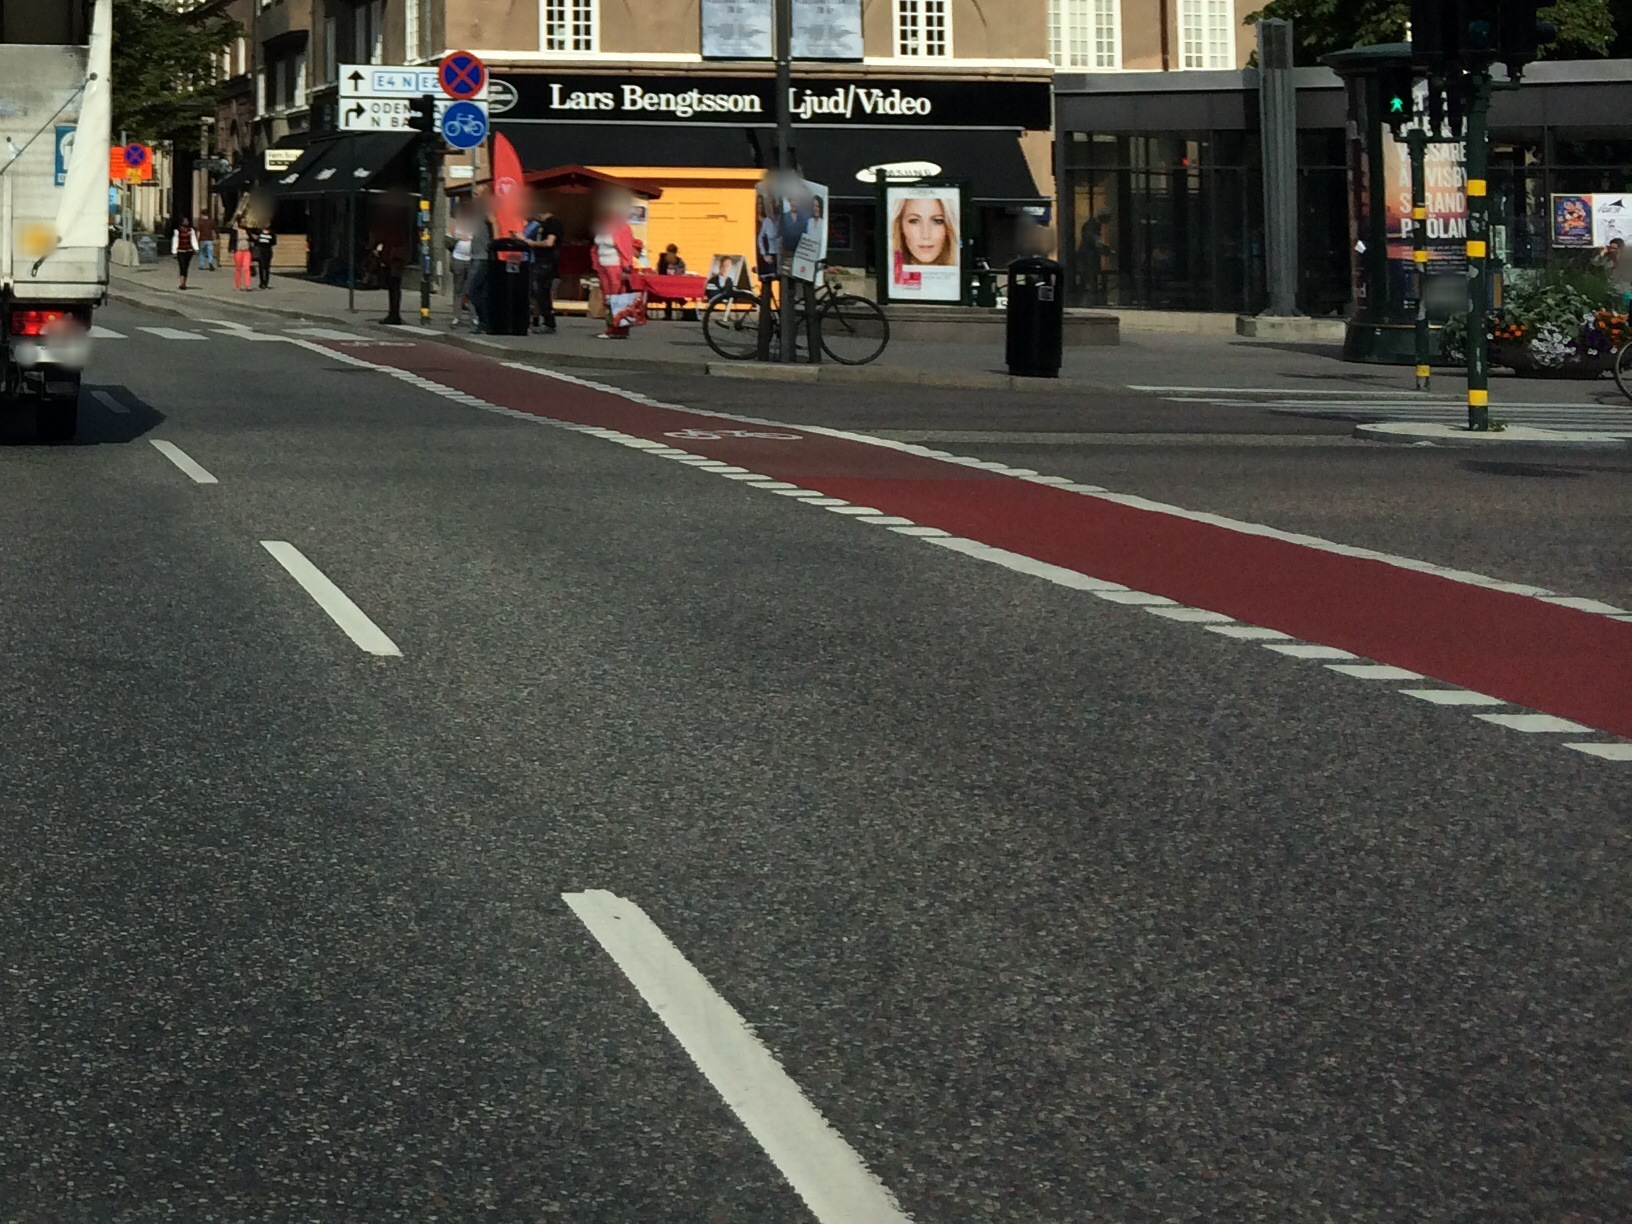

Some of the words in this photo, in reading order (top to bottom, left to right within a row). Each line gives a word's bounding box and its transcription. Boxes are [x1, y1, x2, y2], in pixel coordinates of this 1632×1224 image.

[378, 75, 395, 87] E4
[402, 76, 412, 88] N
[549, 84, 614, 110] Lars
[621, 85, 763, 117] Bengtsson
[788, 85, 932, 119] Ljud/Video
[1399, 192, 1465, 213] SRAND
[1426, 214, 1467, 239] ÖLAN
